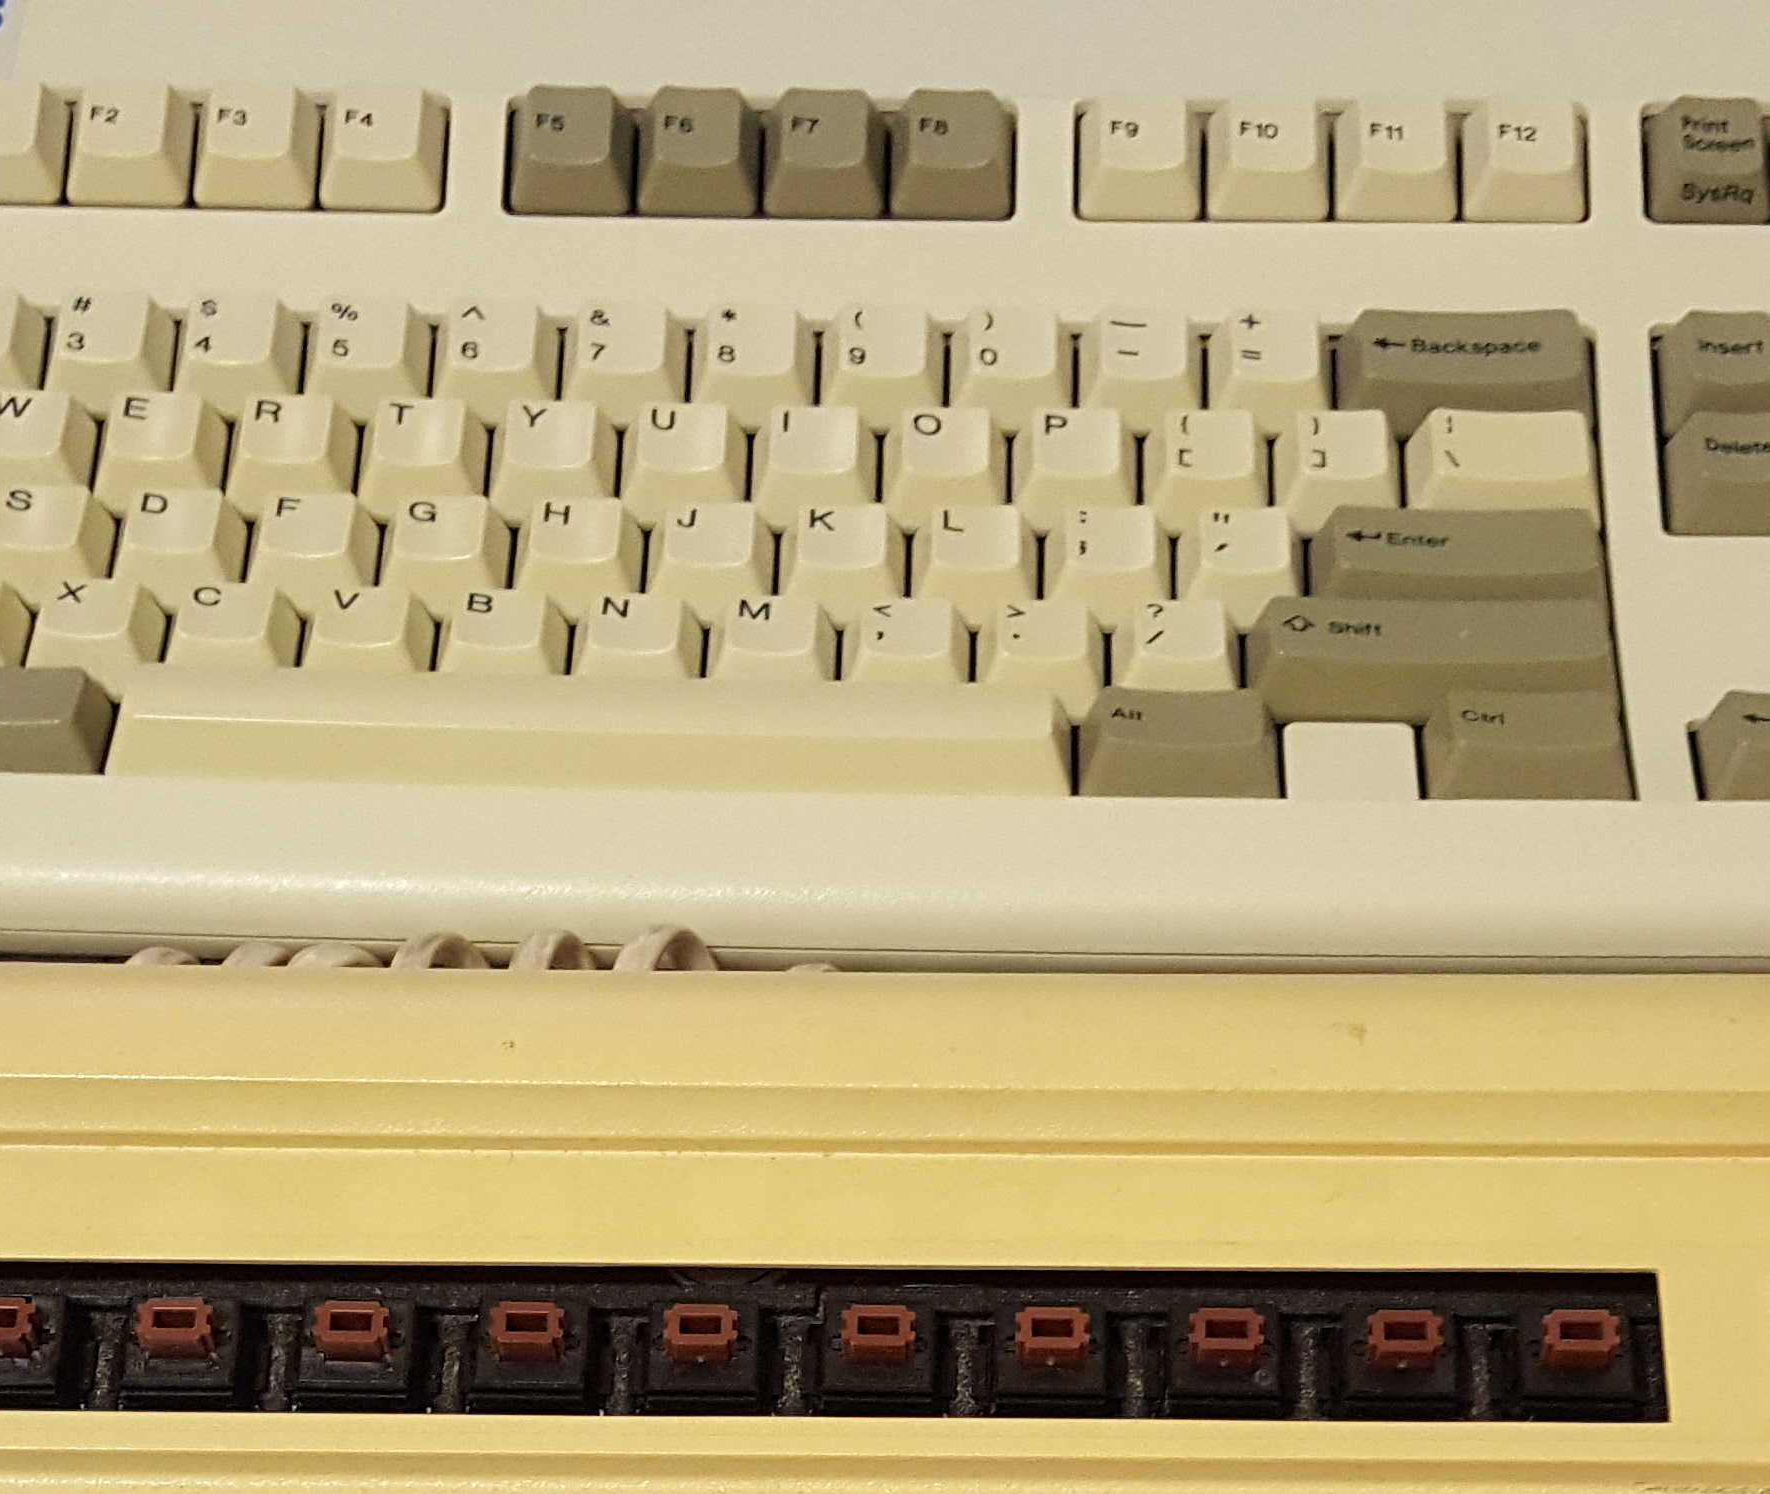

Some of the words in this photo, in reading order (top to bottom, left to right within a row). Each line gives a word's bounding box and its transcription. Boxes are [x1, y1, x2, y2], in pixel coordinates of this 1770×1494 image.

[90, 107, 118, 124] F2
[218, 108, 249, 125] F3
[345, 110, 373, 127] F4
[536, 114, 565, 132] F5
[664, 116, 693, 133] F6
[791, 117, 820, 133] F7
[920, 118, 948, 135] F8
[1110, 121, 1139, 138] F9
[1239, 122, 1278, 139] F10
[1370, 122, 1404, 141] F11
[1499, 124, 1537, 142] F12
[331, 303, 358, 321] %
[67, 333, 84, 349] 3
[195, 336, 210, 353] 4
[332, 339, 349, 357] 5
[461, 341, 479, 359] 6
[1410, 336, 1541, 357] Backspace
[1698, 338, 1763, 355] Insert
[589, 343, 606, 360] 7
[717, 345, 736, 364] 8
[849, 348, 866, 365] 9
[124, 398, 150, 420] E
[256, 401, 283, 423] R
[390, 403, 414, 425] T
[522, 405, 547, 428] Y
[651, 408, 675, 430] U
[913, 414, 942, 436] O
[1045, 415, 1068, 435] P
[5, 490, 33, 511] S
[140, 493, 168, 515] D
[275, 497, 301, 519] F
[409, 502, 437, 523] G
[543, 502, 571, 525] H
[677, 509, 698, 528] J
[809, 510, 835, 531] K
[943, 511, 964, 531] L
[1386, 532, 1449, 548] Enter
[58, 581, 86, 602] X
[193, 587, 223, 607] C
[334, 590, 360, 610] V
[466, 593, 494, 614] B
[601, 597, 630, 618] N
[738, 599, 772, 620] M
[1328, 620, 1382, 637] Shift
[1111, 708, 1143, 720] Alt
[1461, 708, 1504, 725] Ctrl
